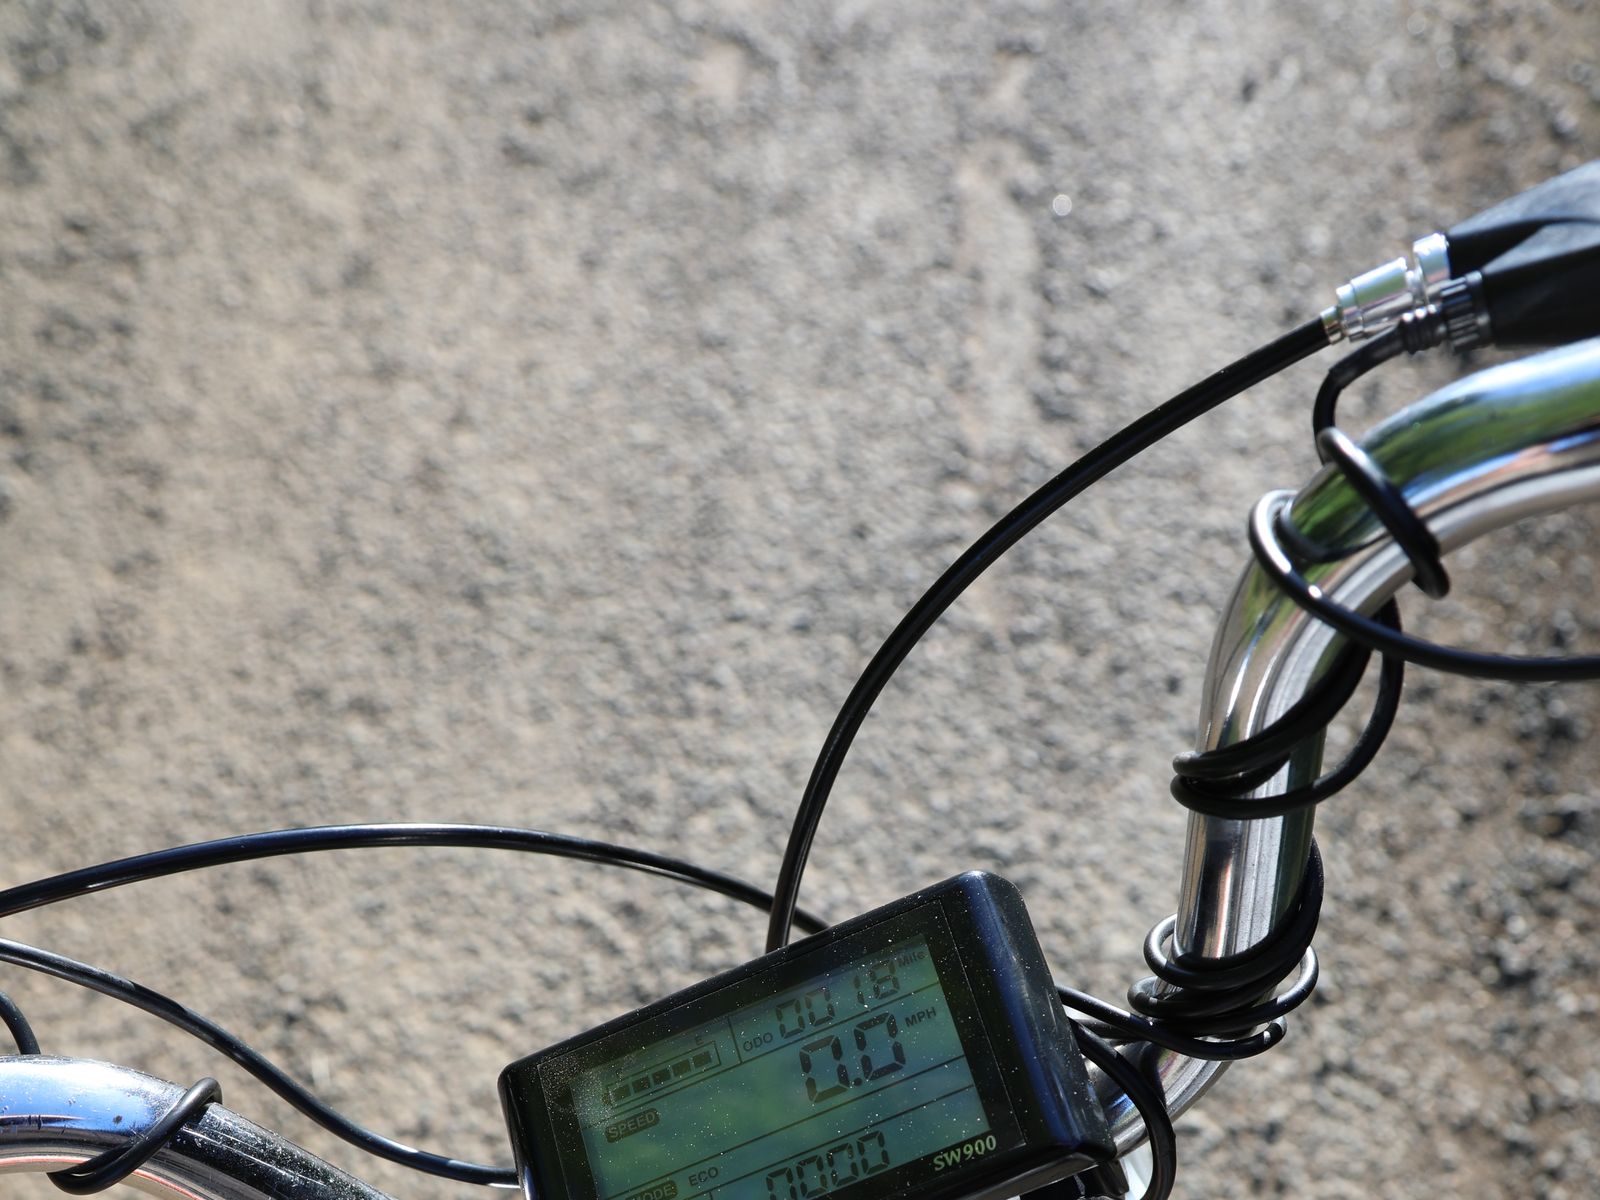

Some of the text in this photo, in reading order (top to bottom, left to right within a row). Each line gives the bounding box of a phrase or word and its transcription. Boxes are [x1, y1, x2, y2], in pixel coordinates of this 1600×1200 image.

[742, 1031, 773, 1052] ODO
[775, 959, 900, 1039] 0018
[799, 1006, 937, 1103] 0.0 MPH
[607, 1111, 656, 1138] SPEED
[932, 1135, 997, 1172] SW900
[688, 1166, 719, 1187] ECO
